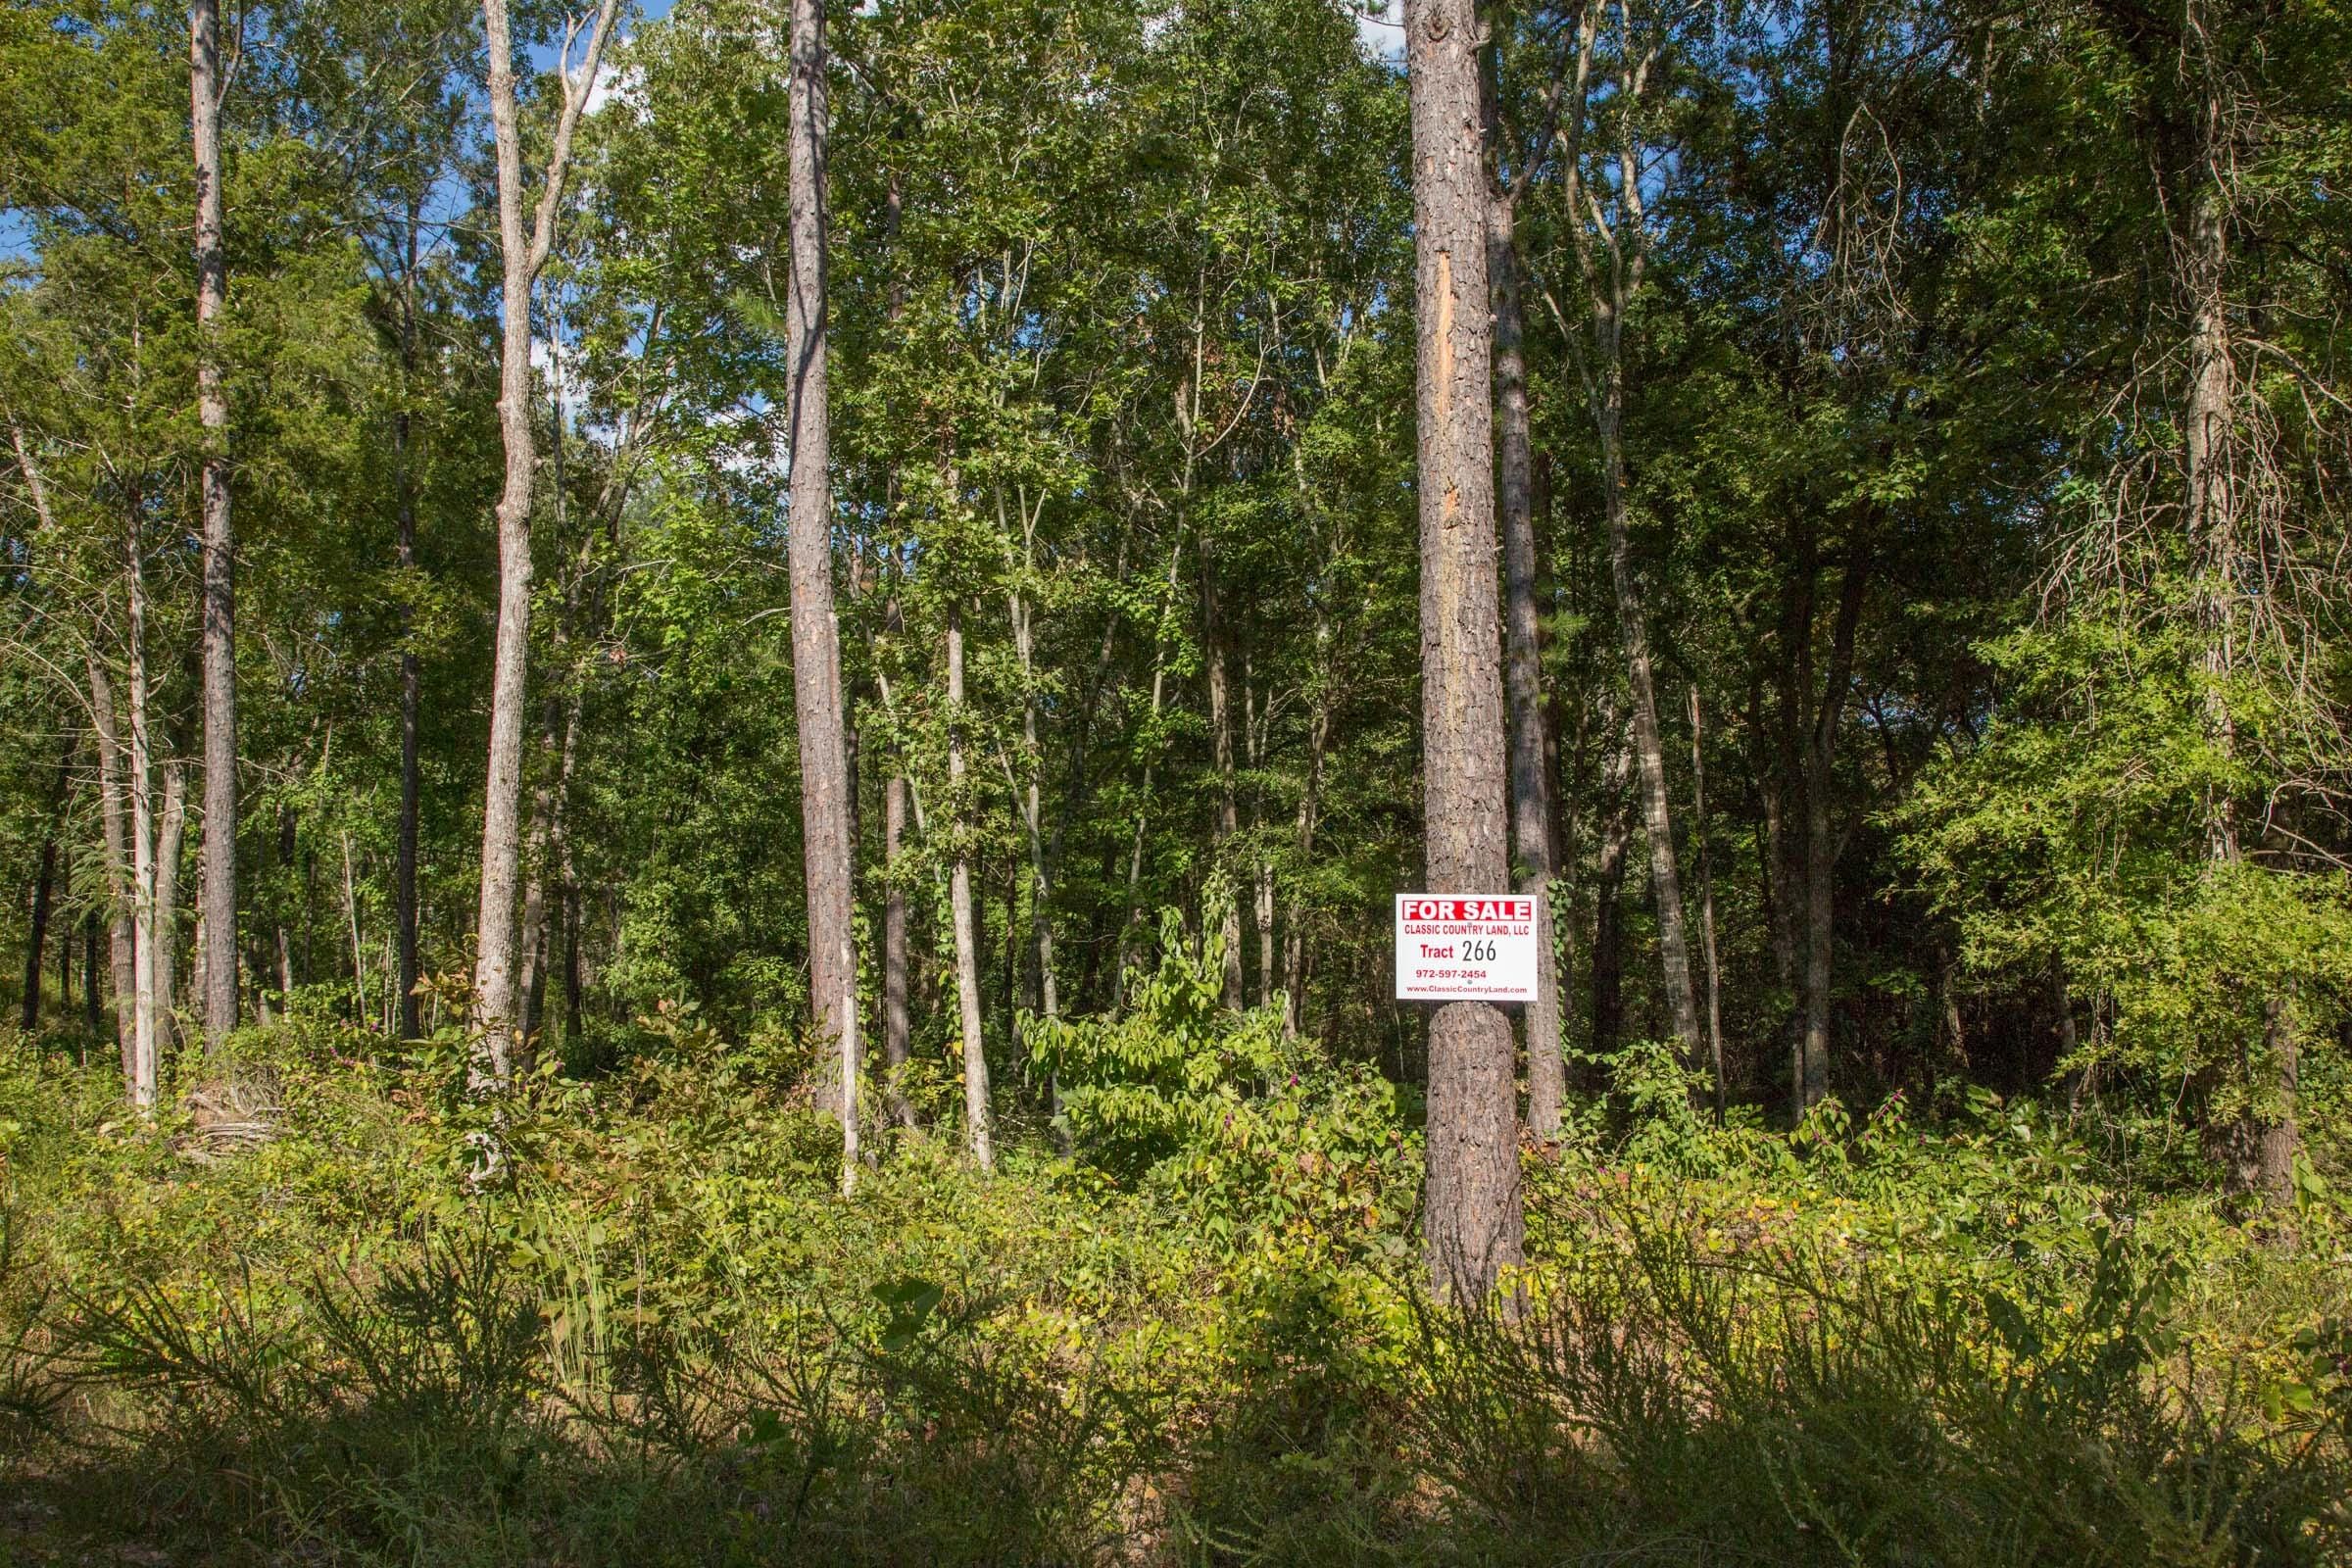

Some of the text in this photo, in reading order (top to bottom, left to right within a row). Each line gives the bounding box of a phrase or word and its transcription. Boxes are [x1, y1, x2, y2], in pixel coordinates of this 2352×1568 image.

[1403, 901, 1530, 920] FOR SALE
[1404, 924, 1530, 937] CLASSIC COUNTRY LAND, LLC
[1420, 940, 1496, 961] Tract 266
[1415, 969, 1487, 979] 972-597-2454
[1406, 985, 1528, 994] www.ClassicCountryLand.com
